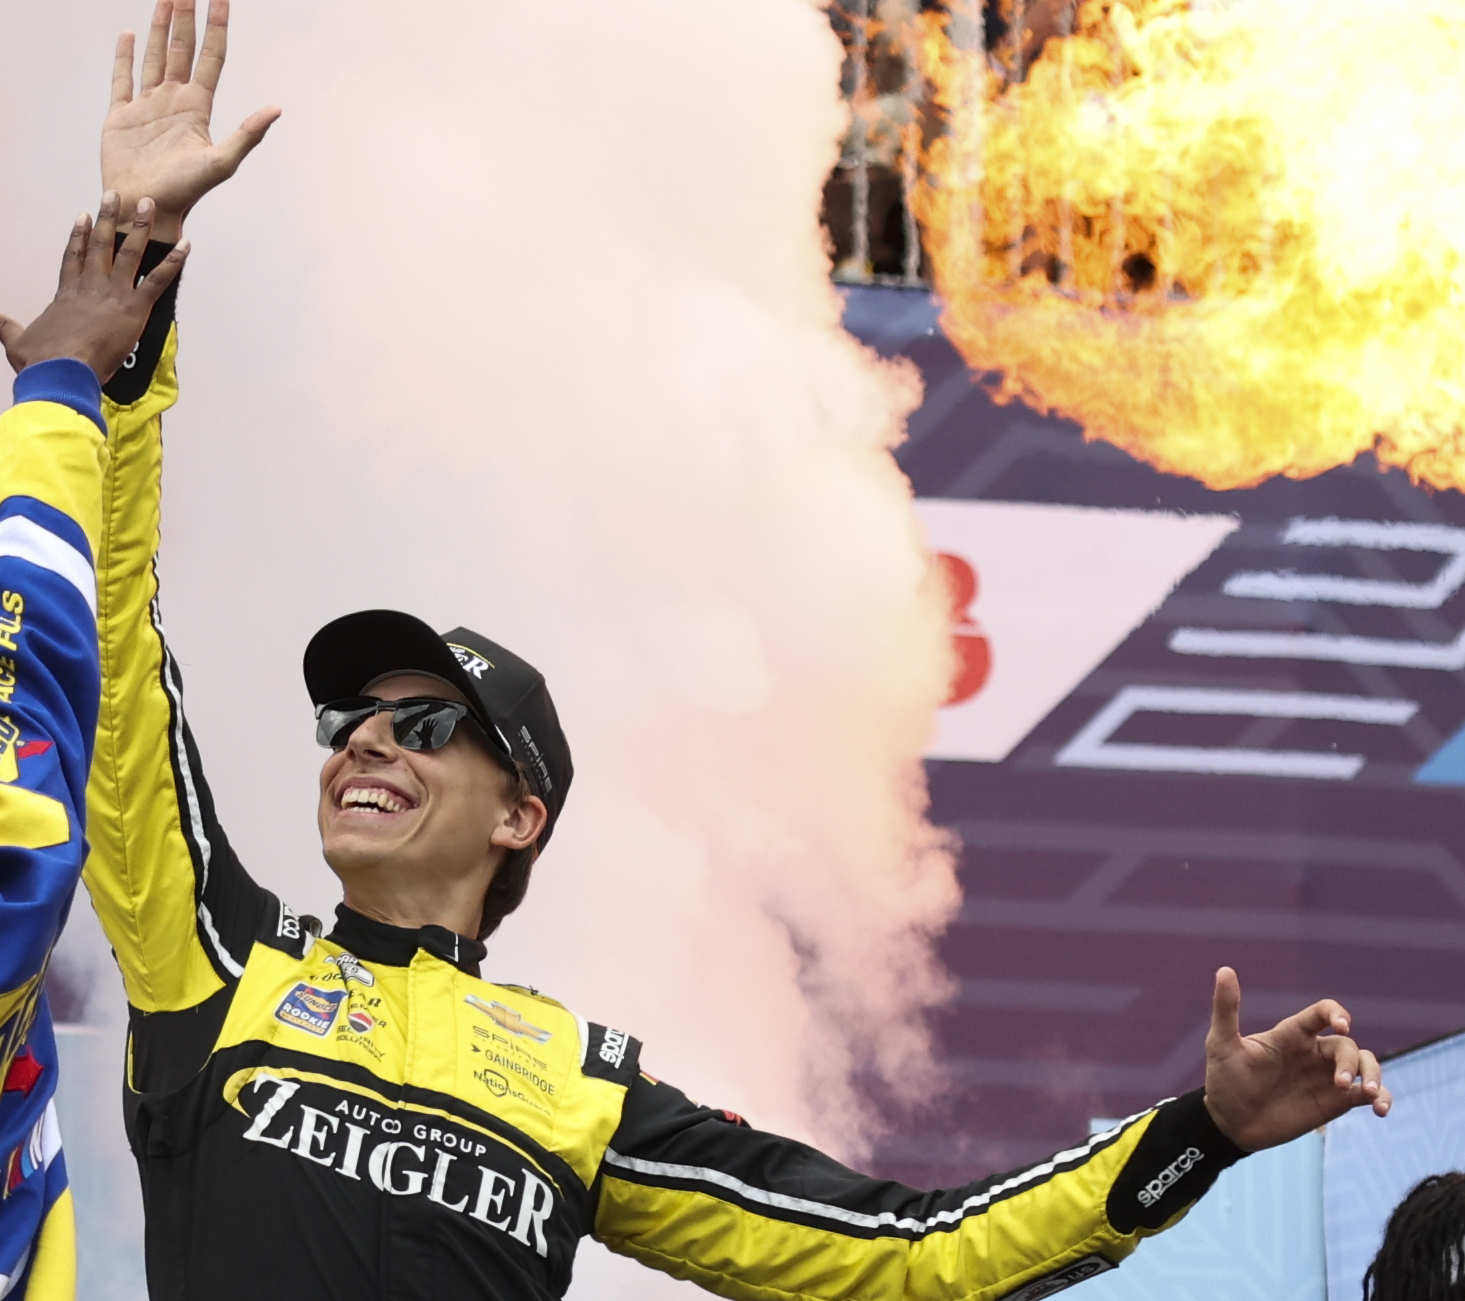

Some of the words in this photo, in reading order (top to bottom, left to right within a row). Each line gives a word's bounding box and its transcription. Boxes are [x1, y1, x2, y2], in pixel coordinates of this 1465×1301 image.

[282, 1002, 331, 1030] ROOKIE
[484, 1049, 556, 1097] GAINBRIDGE
[334, 1099, 402, 1135] AUTO
[413, 1124, 488, 1157] GROUP
[242, 1071, 555, 1260] ZEIGLER
[1136, 1146, 1205, 1208] sparco
